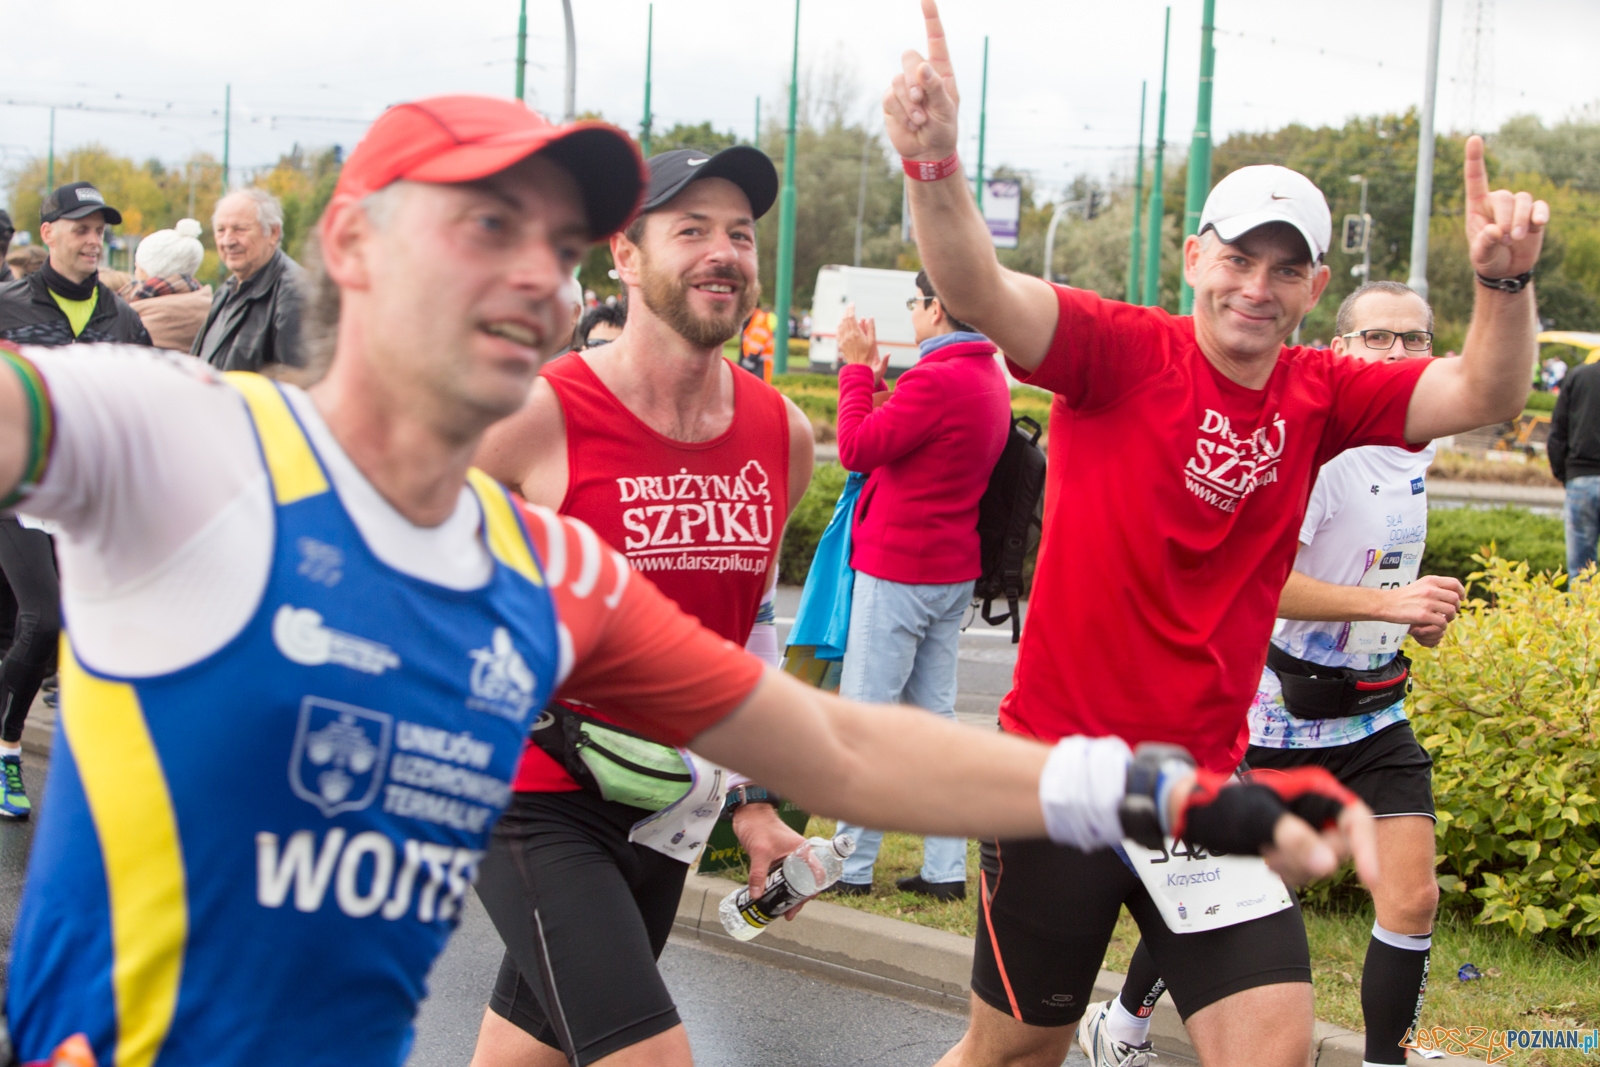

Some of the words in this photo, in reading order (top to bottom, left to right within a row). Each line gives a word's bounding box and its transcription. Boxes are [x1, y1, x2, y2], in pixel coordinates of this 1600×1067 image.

[616, 467, 751, 503] DRUŻYNA
[622, 500, 774, 551] SZPIKU
[629, 552, 768, 576] www.darszpiku.pl
[1166, 867, 1221, 887] Krzysztof
[1204, 904, 1220, 915] 4F
